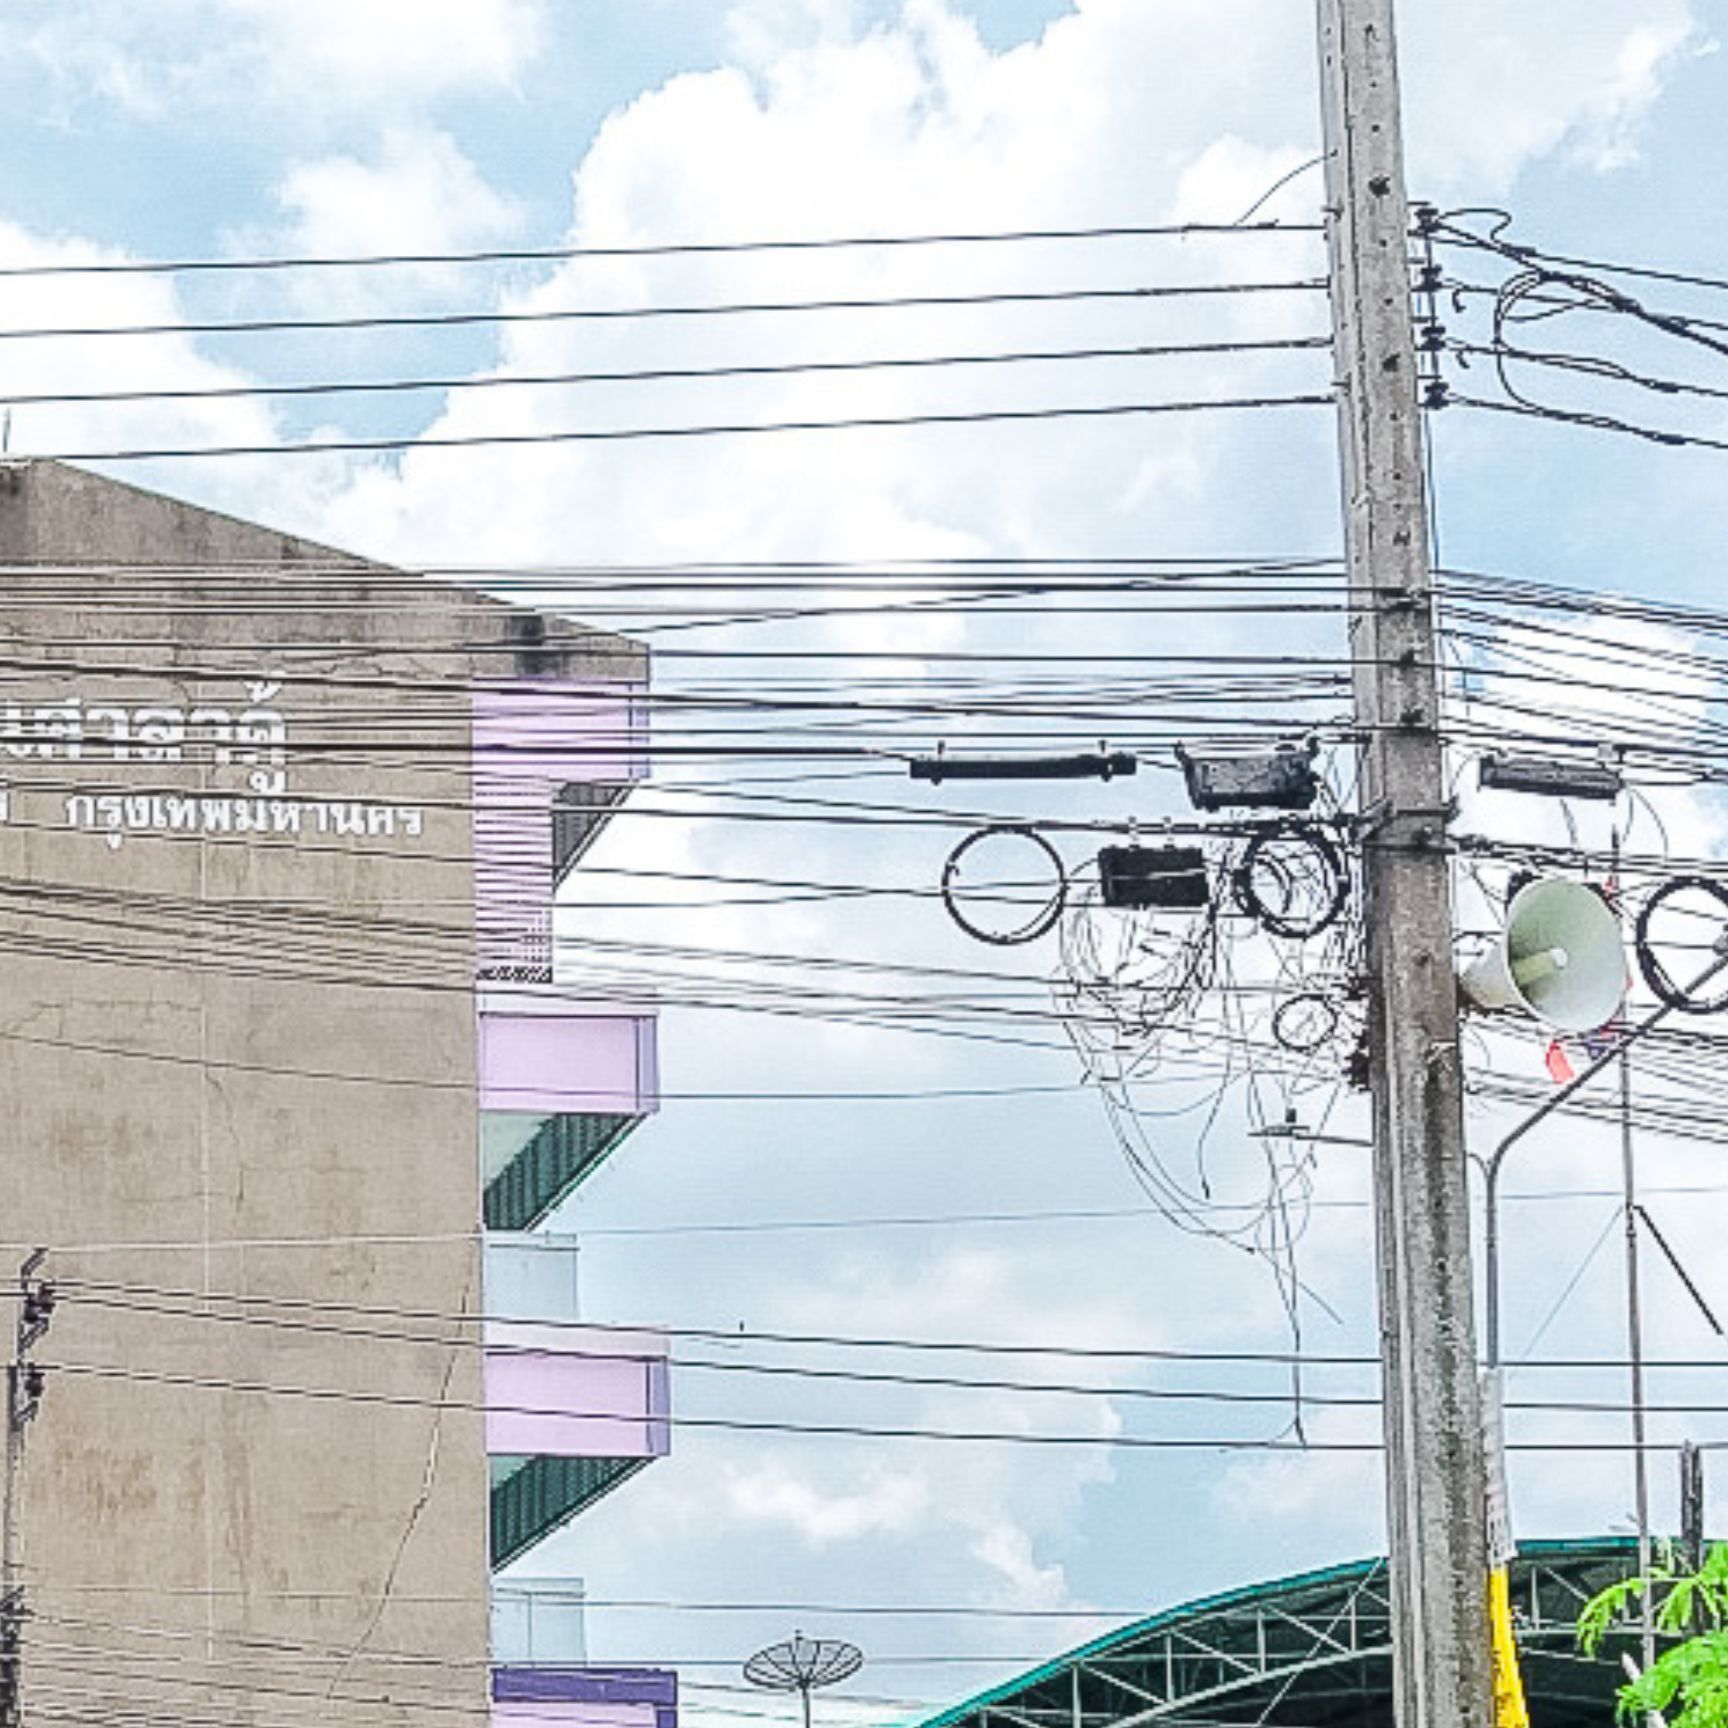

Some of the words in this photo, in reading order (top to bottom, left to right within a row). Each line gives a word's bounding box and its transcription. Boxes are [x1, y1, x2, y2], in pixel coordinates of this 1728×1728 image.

[64, 795, 423, 850] กรุงเทพมหานคร
